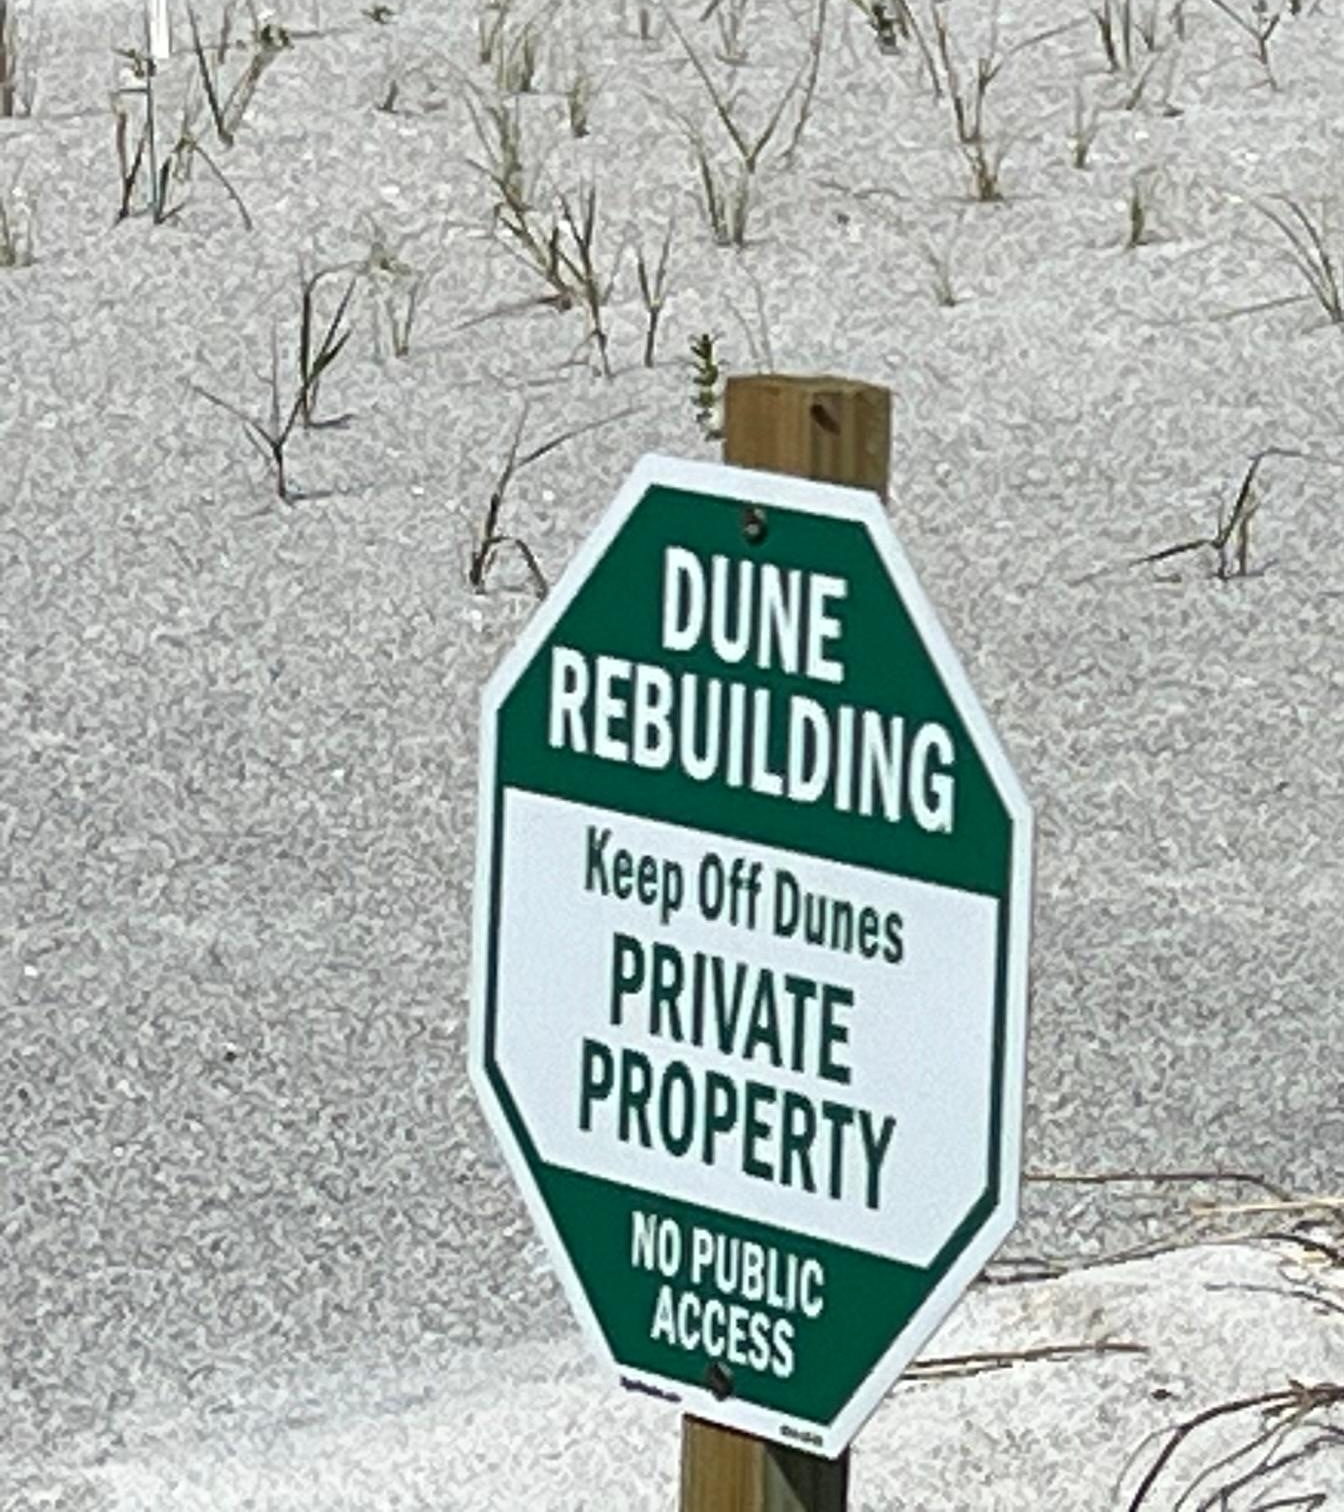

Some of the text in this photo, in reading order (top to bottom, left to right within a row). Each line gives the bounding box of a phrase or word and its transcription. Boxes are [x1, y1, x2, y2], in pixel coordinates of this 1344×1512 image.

[661, 545, 848, 684] DUNE
[548, 645, 956, 834] REBUILDING
[583, 825, 904, 964] Keep Off Dunes
[610, 931, 854, 1085] PRIVATE
[579, 1036, 897, 1210] PROPERTY
[631, 1210, 824, 1318] NO PUBLIC
[650, 1285, 795, 1378] ACCESS
